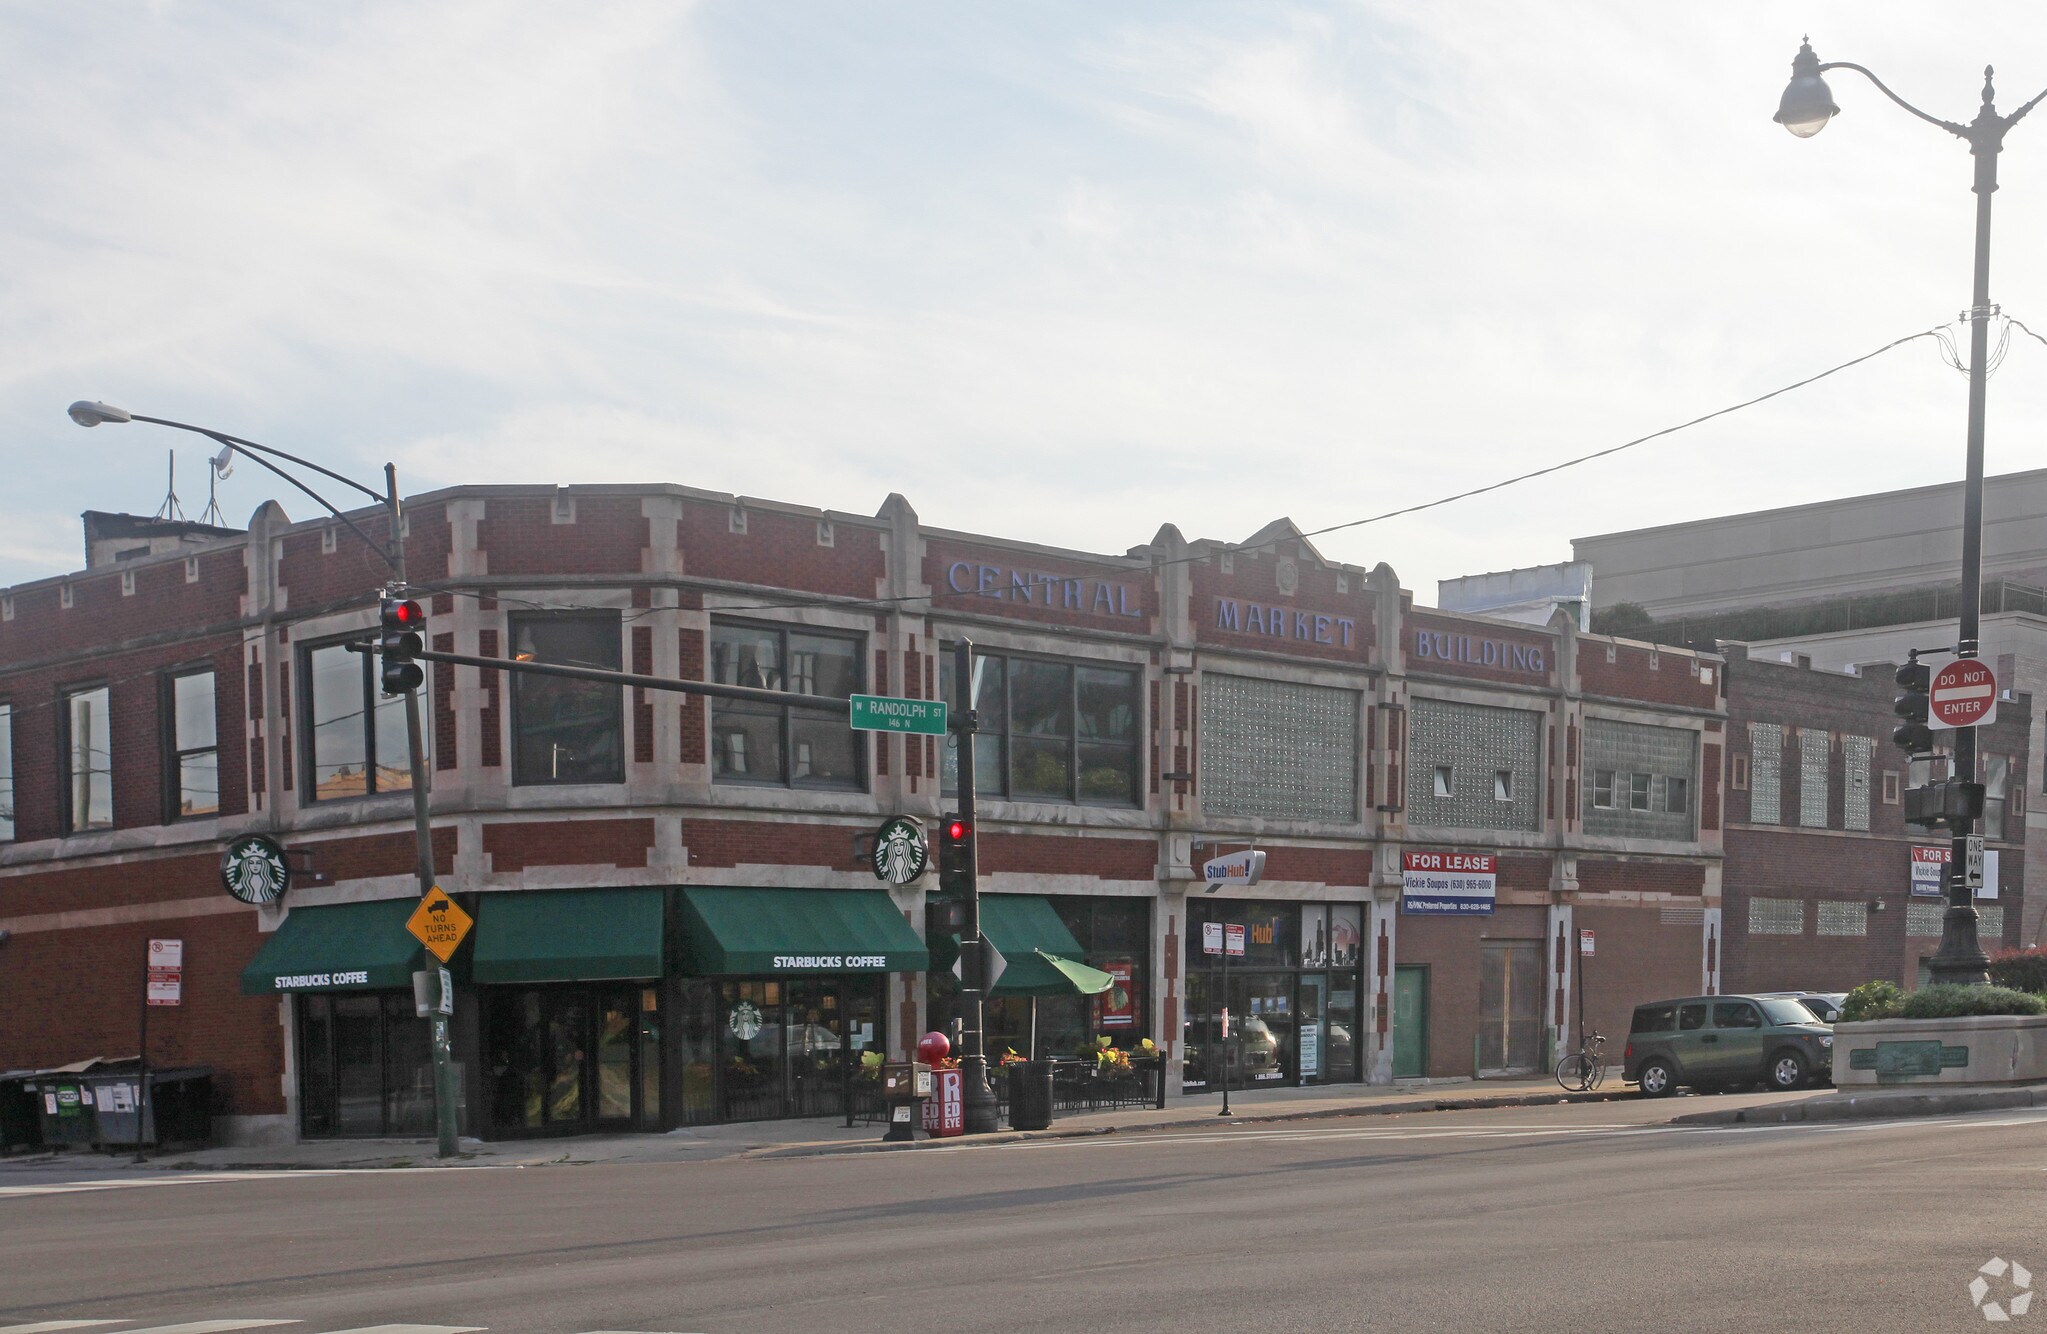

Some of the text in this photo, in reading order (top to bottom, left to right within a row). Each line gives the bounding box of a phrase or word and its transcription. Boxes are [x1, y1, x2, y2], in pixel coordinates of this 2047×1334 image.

[949, 561, 1142, 618] CENTRAL
[1217, 599, 1356, 647] MARKET
[1416, 630, 1544, 673] BUILDING
[1940, 670, 1986, 686] DO NOT
[855, 700, 942, 718] W RANDOLPH ST
[1944, 701, 1981, 715] ENTER
[888, 718, 911, 728] 146 N
[1968, 839, 1982, 852] ONE
[1412, 854, 1489, 870] FOR LEASE
[1923, 849, 1942, 861] FOR
[1968, 854, 1983, 867] WAY
[1207, 858, 1250, 879] StubHub!
[1405, 877, 1425, 889] Vickie
[1426, 878, 1449, 891] Soupos
[432, 914, 446, 923] NO
[425, 924, 457, 933] TURNS
[427, 934, 457, 943] AHEAD
[773, 956, 886, 968] STARBUCKS COFFEE
[275, 971, 368, 989] STARBUCKS COFFEE
[944, 1117, 960, 1129] EYE
